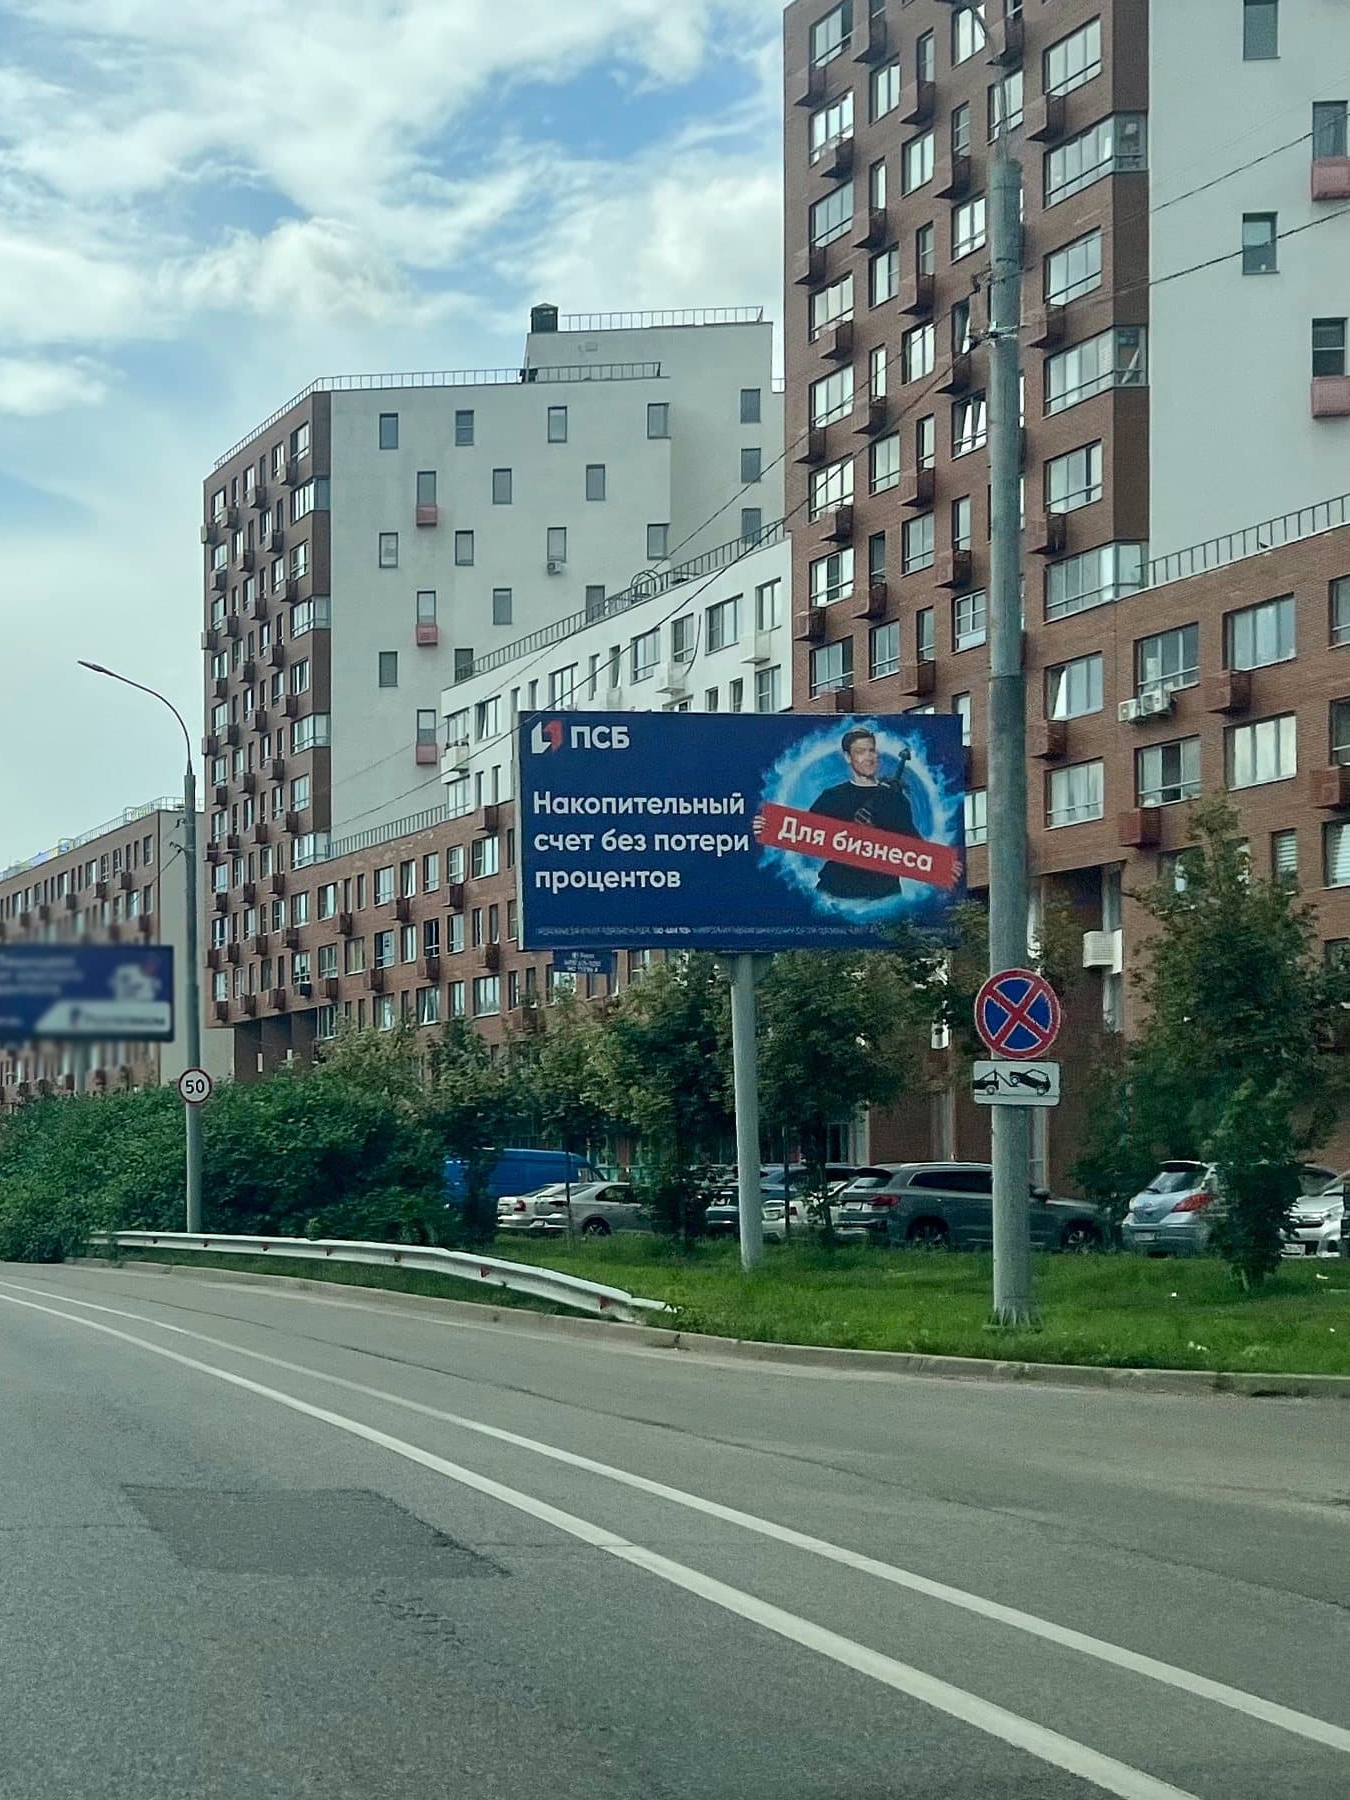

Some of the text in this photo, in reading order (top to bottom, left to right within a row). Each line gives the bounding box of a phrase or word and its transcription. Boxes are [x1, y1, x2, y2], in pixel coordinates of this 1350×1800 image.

[571, 726, 630, 749] ПСБ
[534, 791, 745, 815] Накопительный
[534, 828, 749, 857] счет без потери
[777, 816, 933, 872] Для бизнеса
[535, 870, 681, 894] процентов
[185, 1079, 205, 1094] 50
